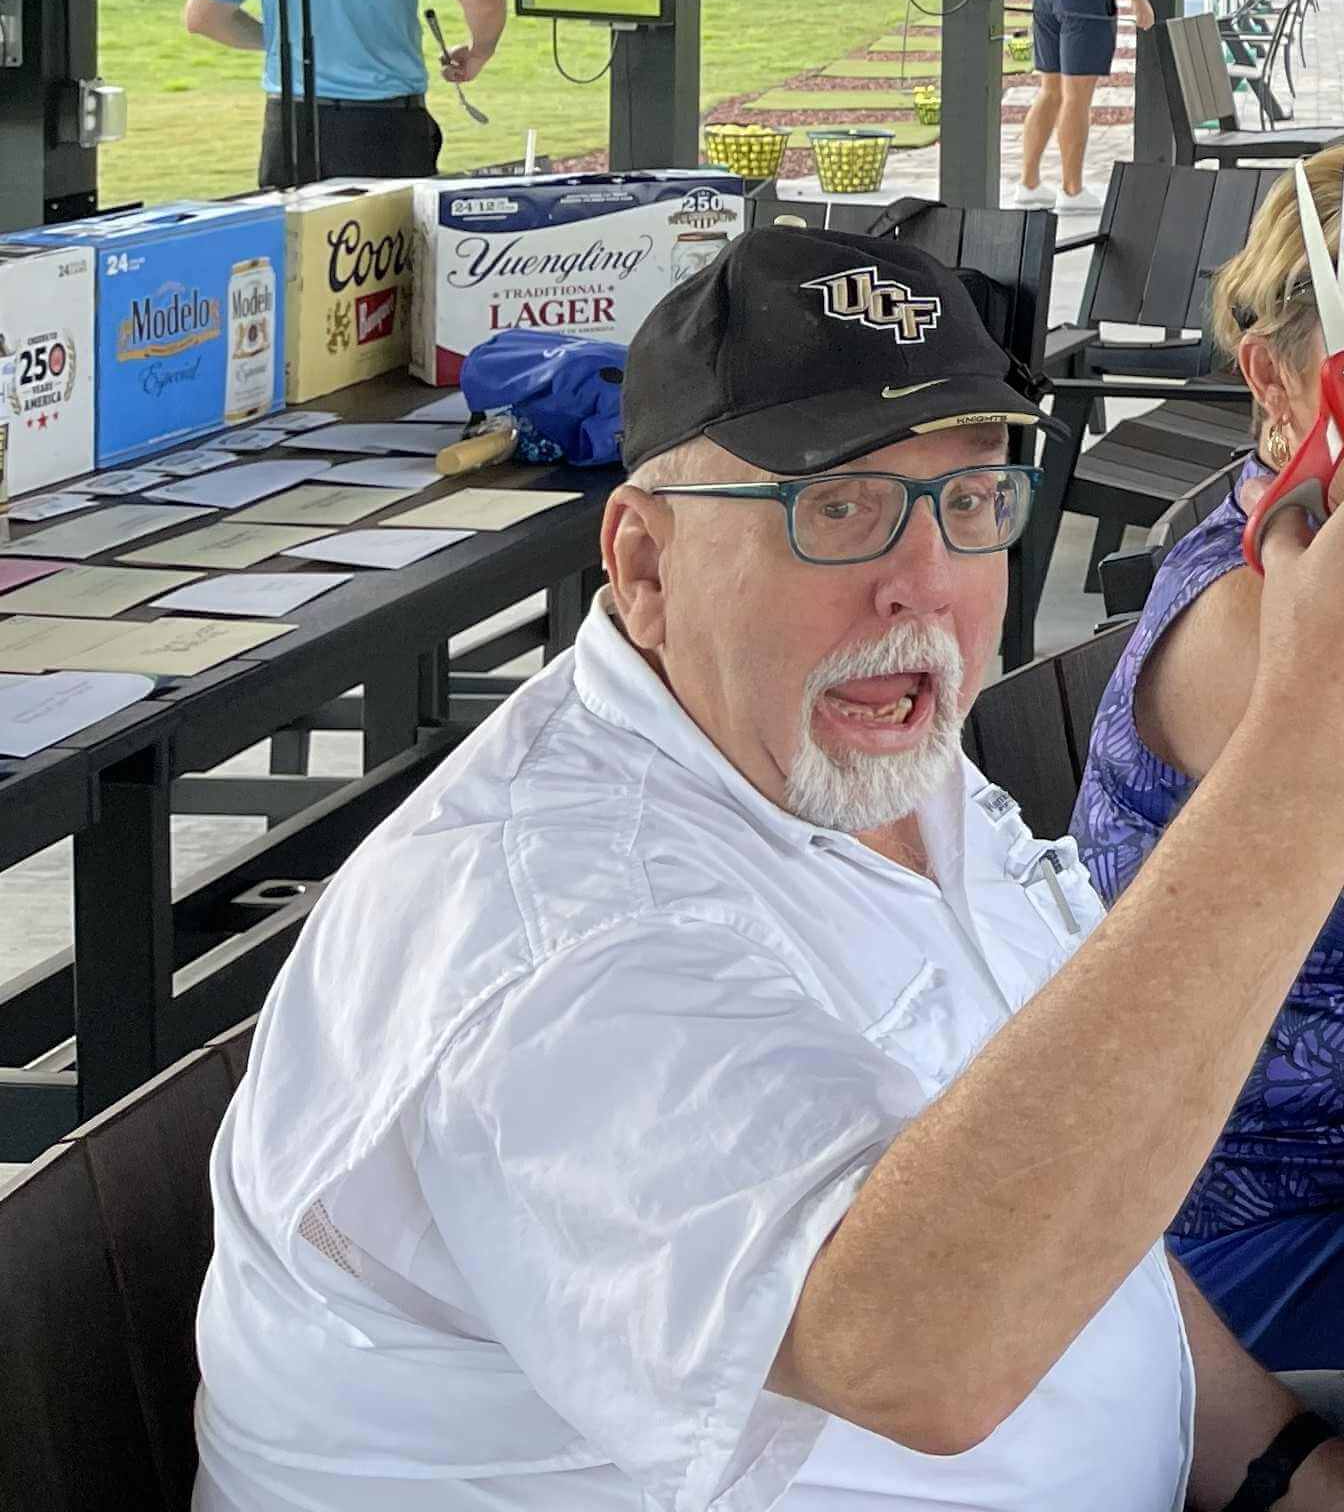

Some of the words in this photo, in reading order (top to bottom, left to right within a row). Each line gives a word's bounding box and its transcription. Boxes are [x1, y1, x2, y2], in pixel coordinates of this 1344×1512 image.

[682, 196, 723, 211] 250
[106, 253, 129, 276] 24
[447, 234, 654, 288] Yuengling
[504, 284, 605, 300] TRADITIONAL
[812, 268, 940, 344] UCF
[132, 290, 209, 345] Modelo
[488, 297, 616, 331] LAGER
[20, 343, 67, 385] 250
[24, 392, 62, 411] AMERICA
[956, 414, 1008, 425] KNIGHTS
